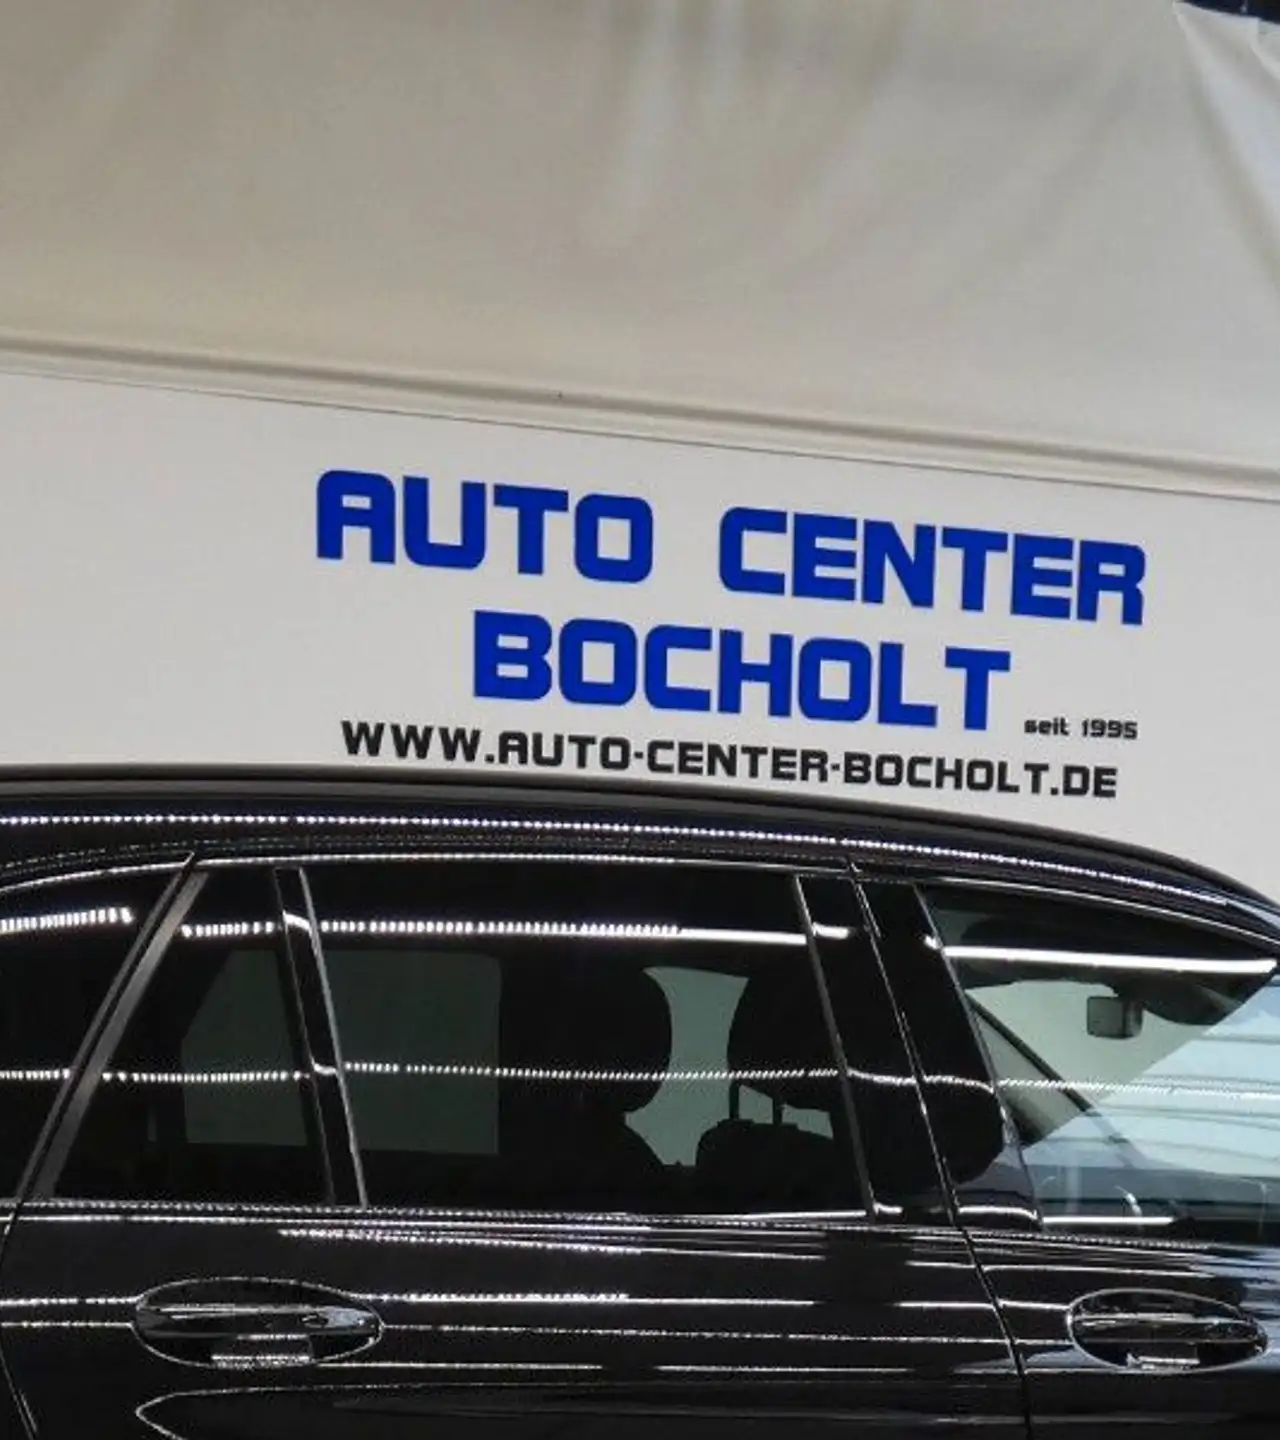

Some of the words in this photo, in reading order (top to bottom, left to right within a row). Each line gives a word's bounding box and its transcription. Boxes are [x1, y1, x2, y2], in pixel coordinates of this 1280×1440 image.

[315, 469, 655, 586] AUTO
[718, 506, 1148, 629] CENTER
[472, 610, 1014, 731] BOCHOLT
[340, 720, 1118, 799] WWW.AUTO-CENTER-BOCHOLT.DE
[1024, 717, 1070, 736] seit
[1081, 718, 1139, 740] 1995
